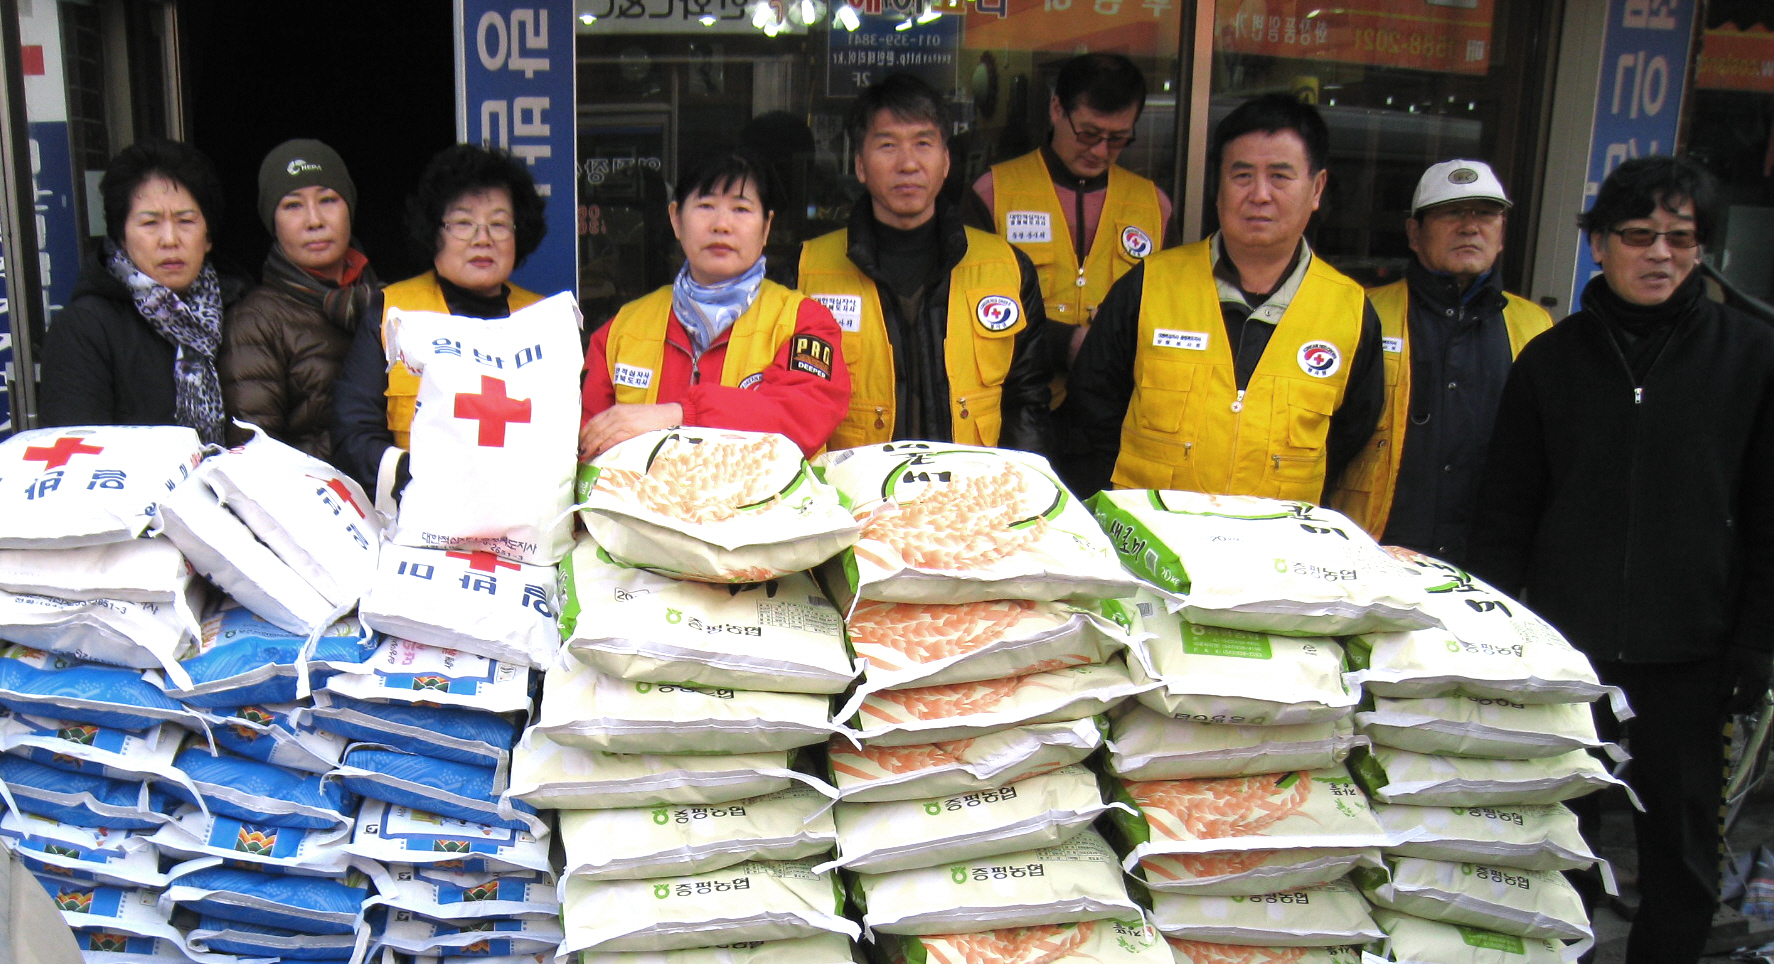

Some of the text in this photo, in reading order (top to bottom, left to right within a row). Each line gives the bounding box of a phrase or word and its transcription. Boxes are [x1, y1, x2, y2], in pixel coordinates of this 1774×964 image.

[944, 786, 1018, 811] 증평농협
[674, 805, 747, 824] 증평농협
[972, 863, 1045, 881] 증평농협
[1476, 865, 1531, 891] 증평농협
[675, 877, 751, 897] 증평농협
